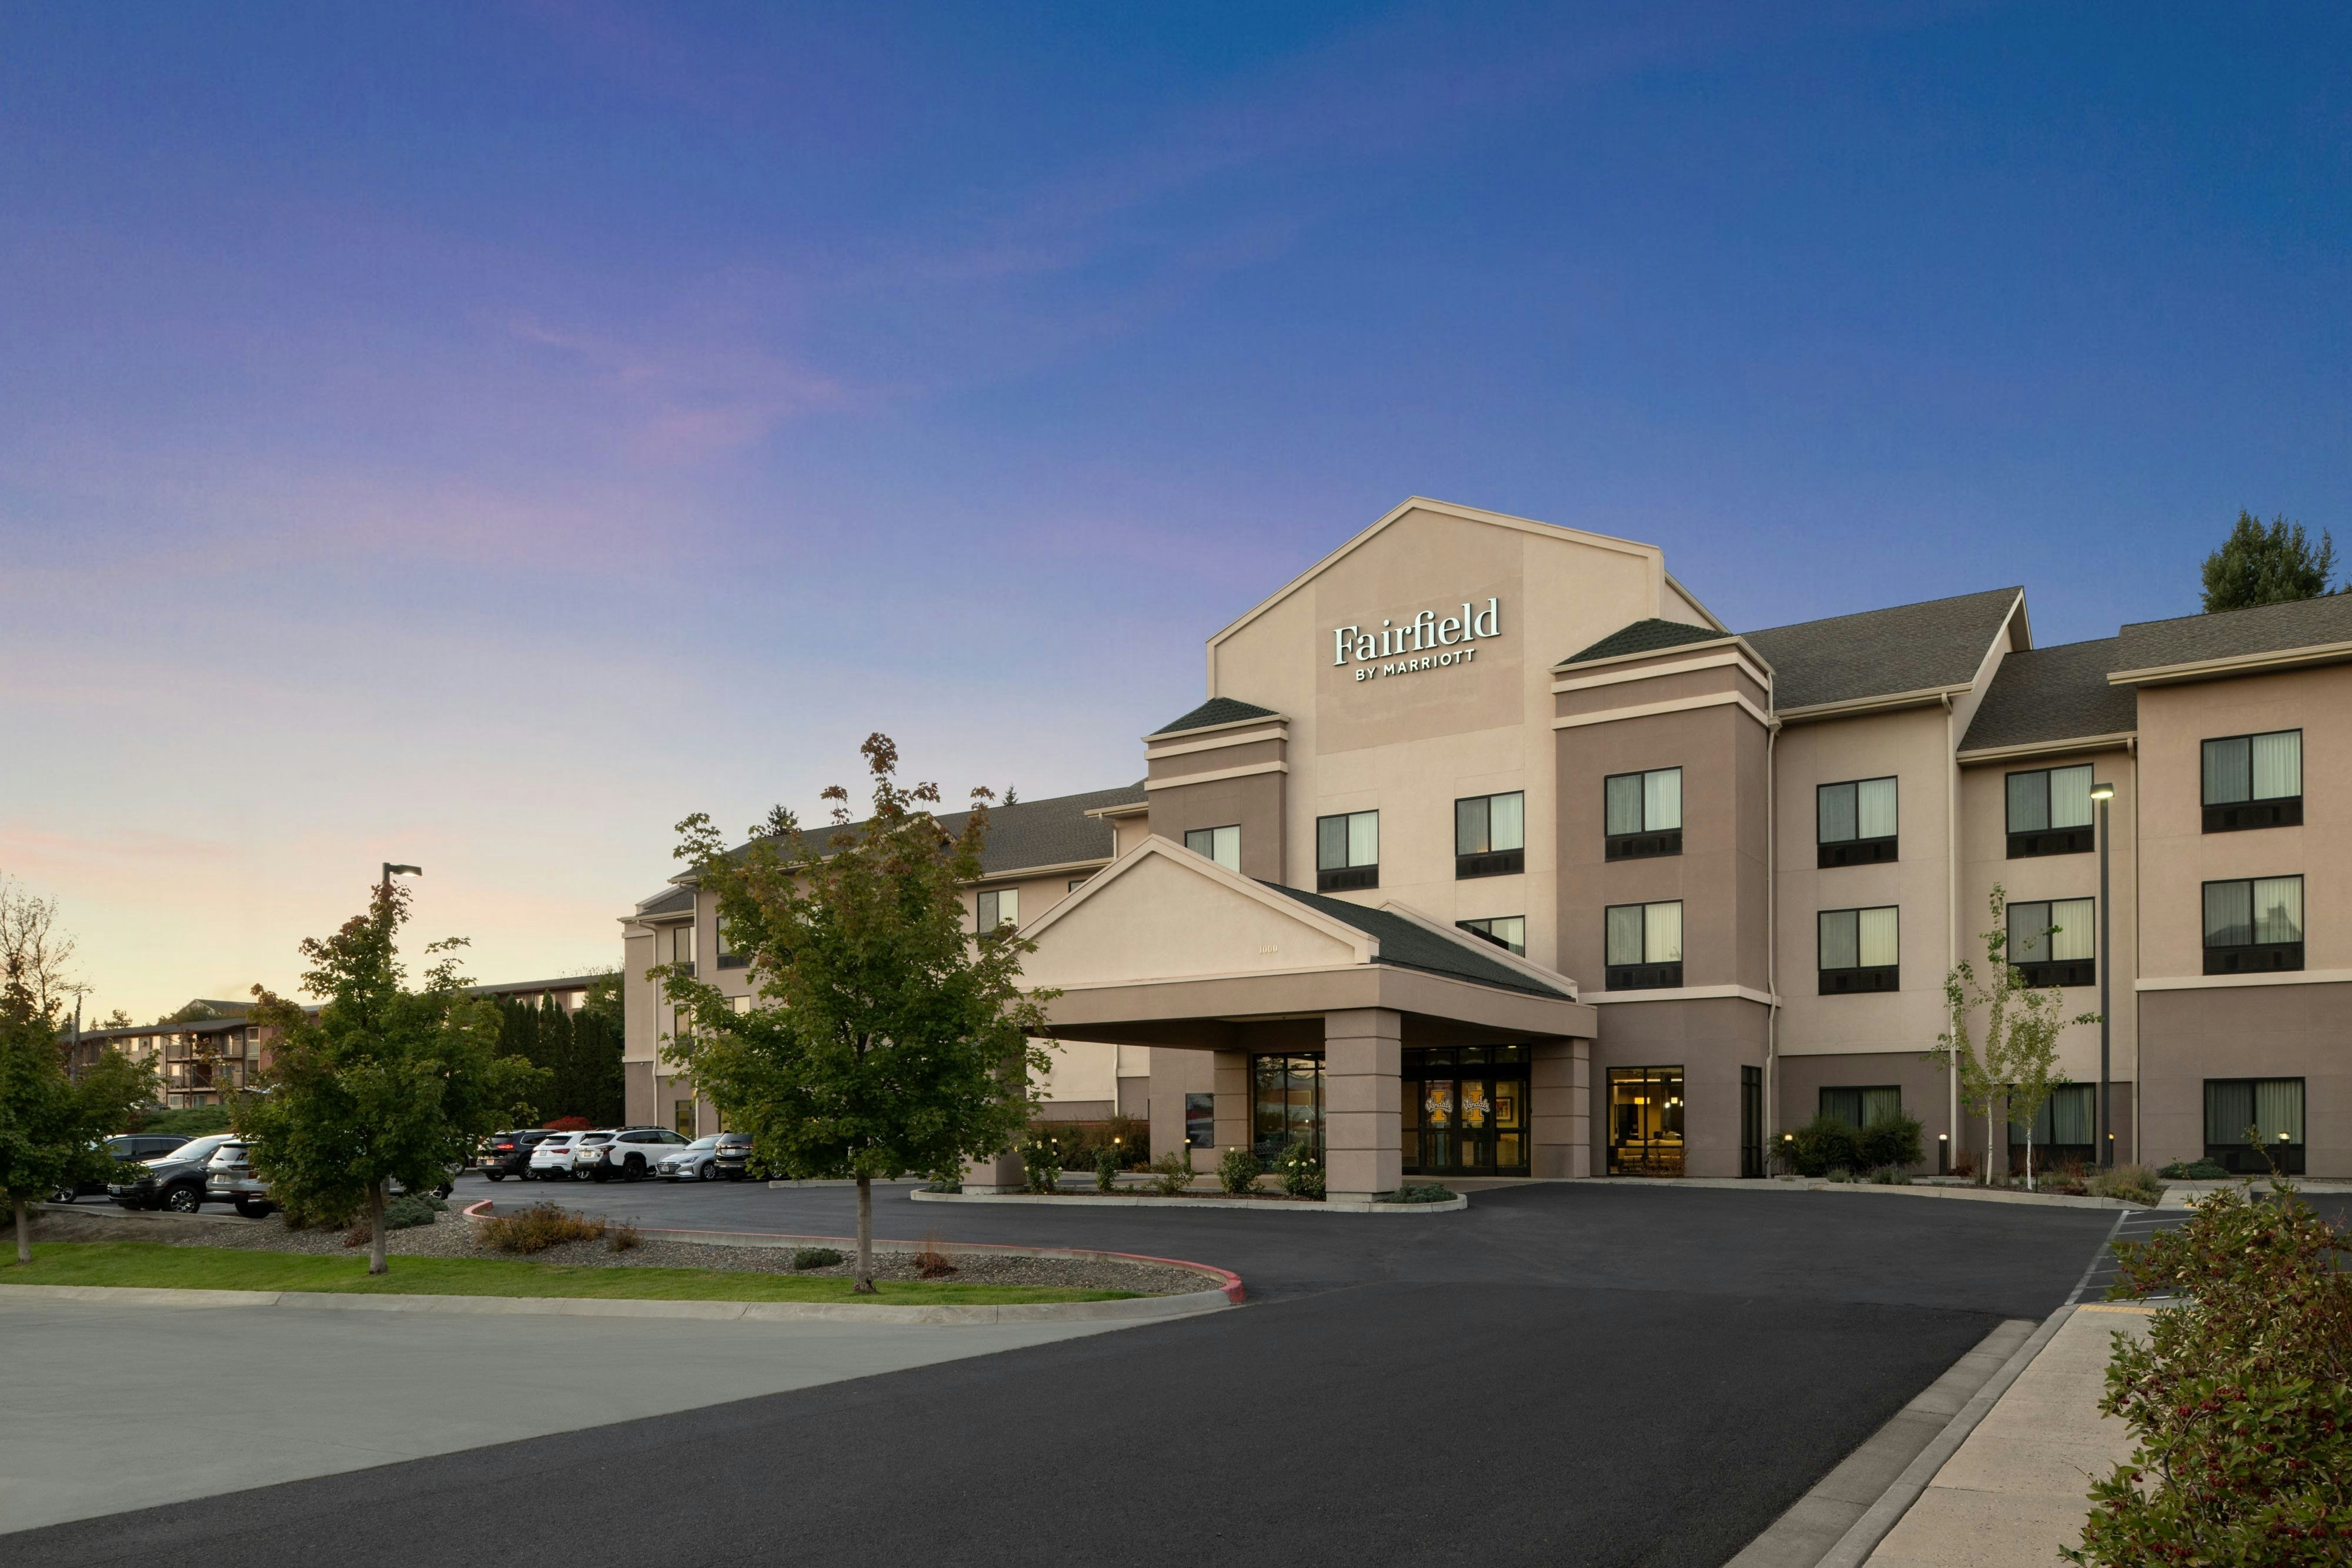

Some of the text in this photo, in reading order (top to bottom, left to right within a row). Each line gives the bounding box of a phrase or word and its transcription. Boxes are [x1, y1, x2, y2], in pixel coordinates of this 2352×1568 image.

[1333, 597, 1501, 666] Fairfield
[1356, 648, 1476, 681] BY MARRIOTT
[1259, 945, 1278, 954] 1000
[1426, 1099, 1452, 1111] Vandals
[1464, 1098, 1489, 1111] Vandals
